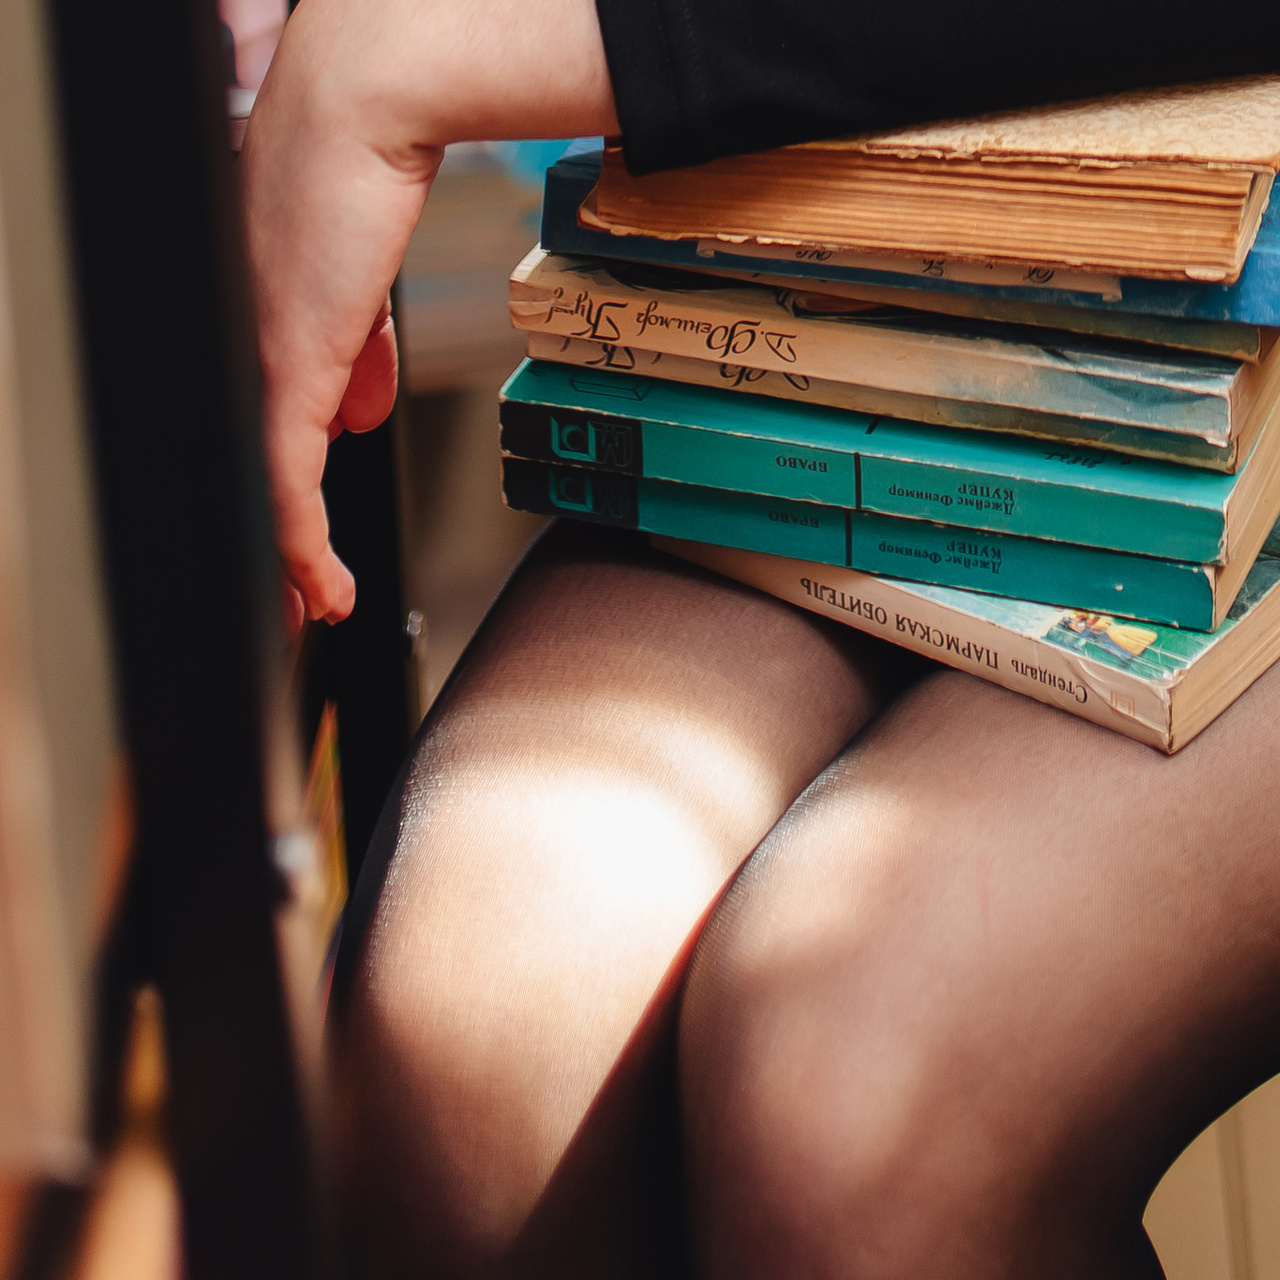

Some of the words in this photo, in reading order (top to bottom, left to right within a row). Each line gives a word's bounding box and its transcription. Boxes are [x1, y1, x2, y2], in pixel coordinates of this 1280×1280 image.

[776, 454, 829, 474] БРАВО
[888, 484, 954, 507] Фенимор
[957, 483, 1014, 502] КУПЕР
[957, 496, 1015, 516] Джеймс
[767, 509, 820, 529] БРАВО
[878, 542, 942, 565] Фенимор
[946, 541, 1002, 560] КУПЕР
[945, 554, 1002, 574] Джеймс
[800, 577, 888, 626] ОБИТЕЛЬ
[895, 613, 999, 670] ПАРМСКАЯ
[1011, 659, 1088, 704] Стендаль
